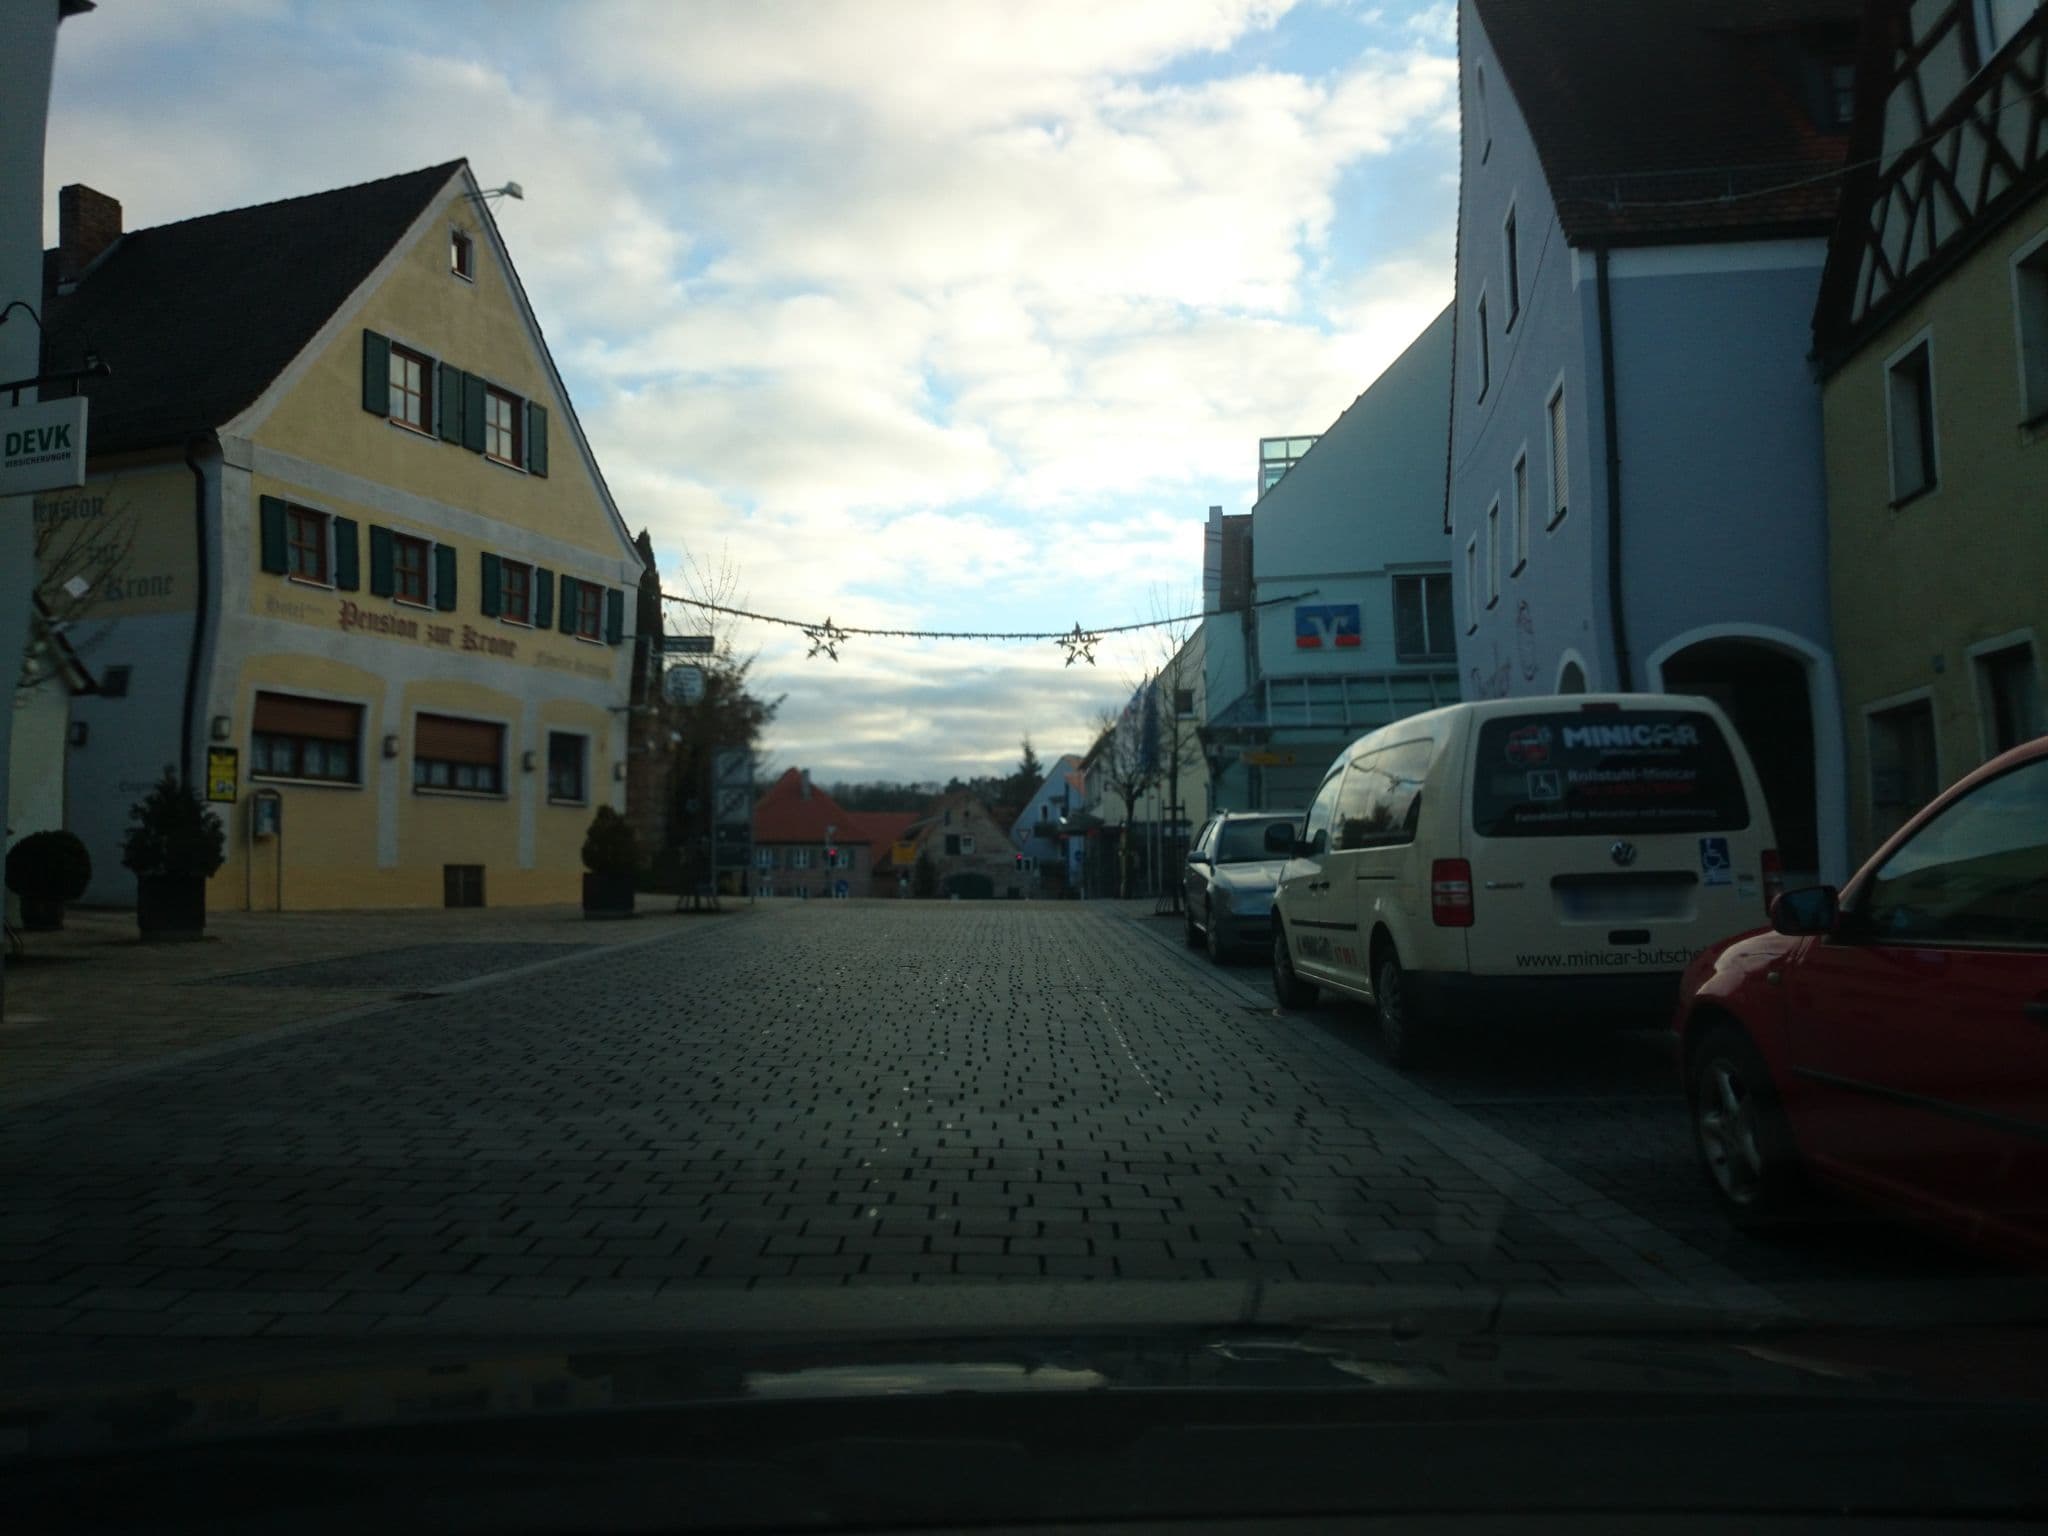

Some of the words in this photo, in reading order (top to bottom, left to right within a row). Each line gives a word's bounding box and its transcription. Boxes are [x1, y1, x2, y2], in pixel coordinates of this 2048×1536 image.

[6, 424, 71, 457] DEVK
[5, 452, 71, 468] VERSICHERUNGEN
[339, 599, 418, 640] Pension
[461, 624, 518, 659] Krone
[1561, 724, 1699, 749] MINICAR
